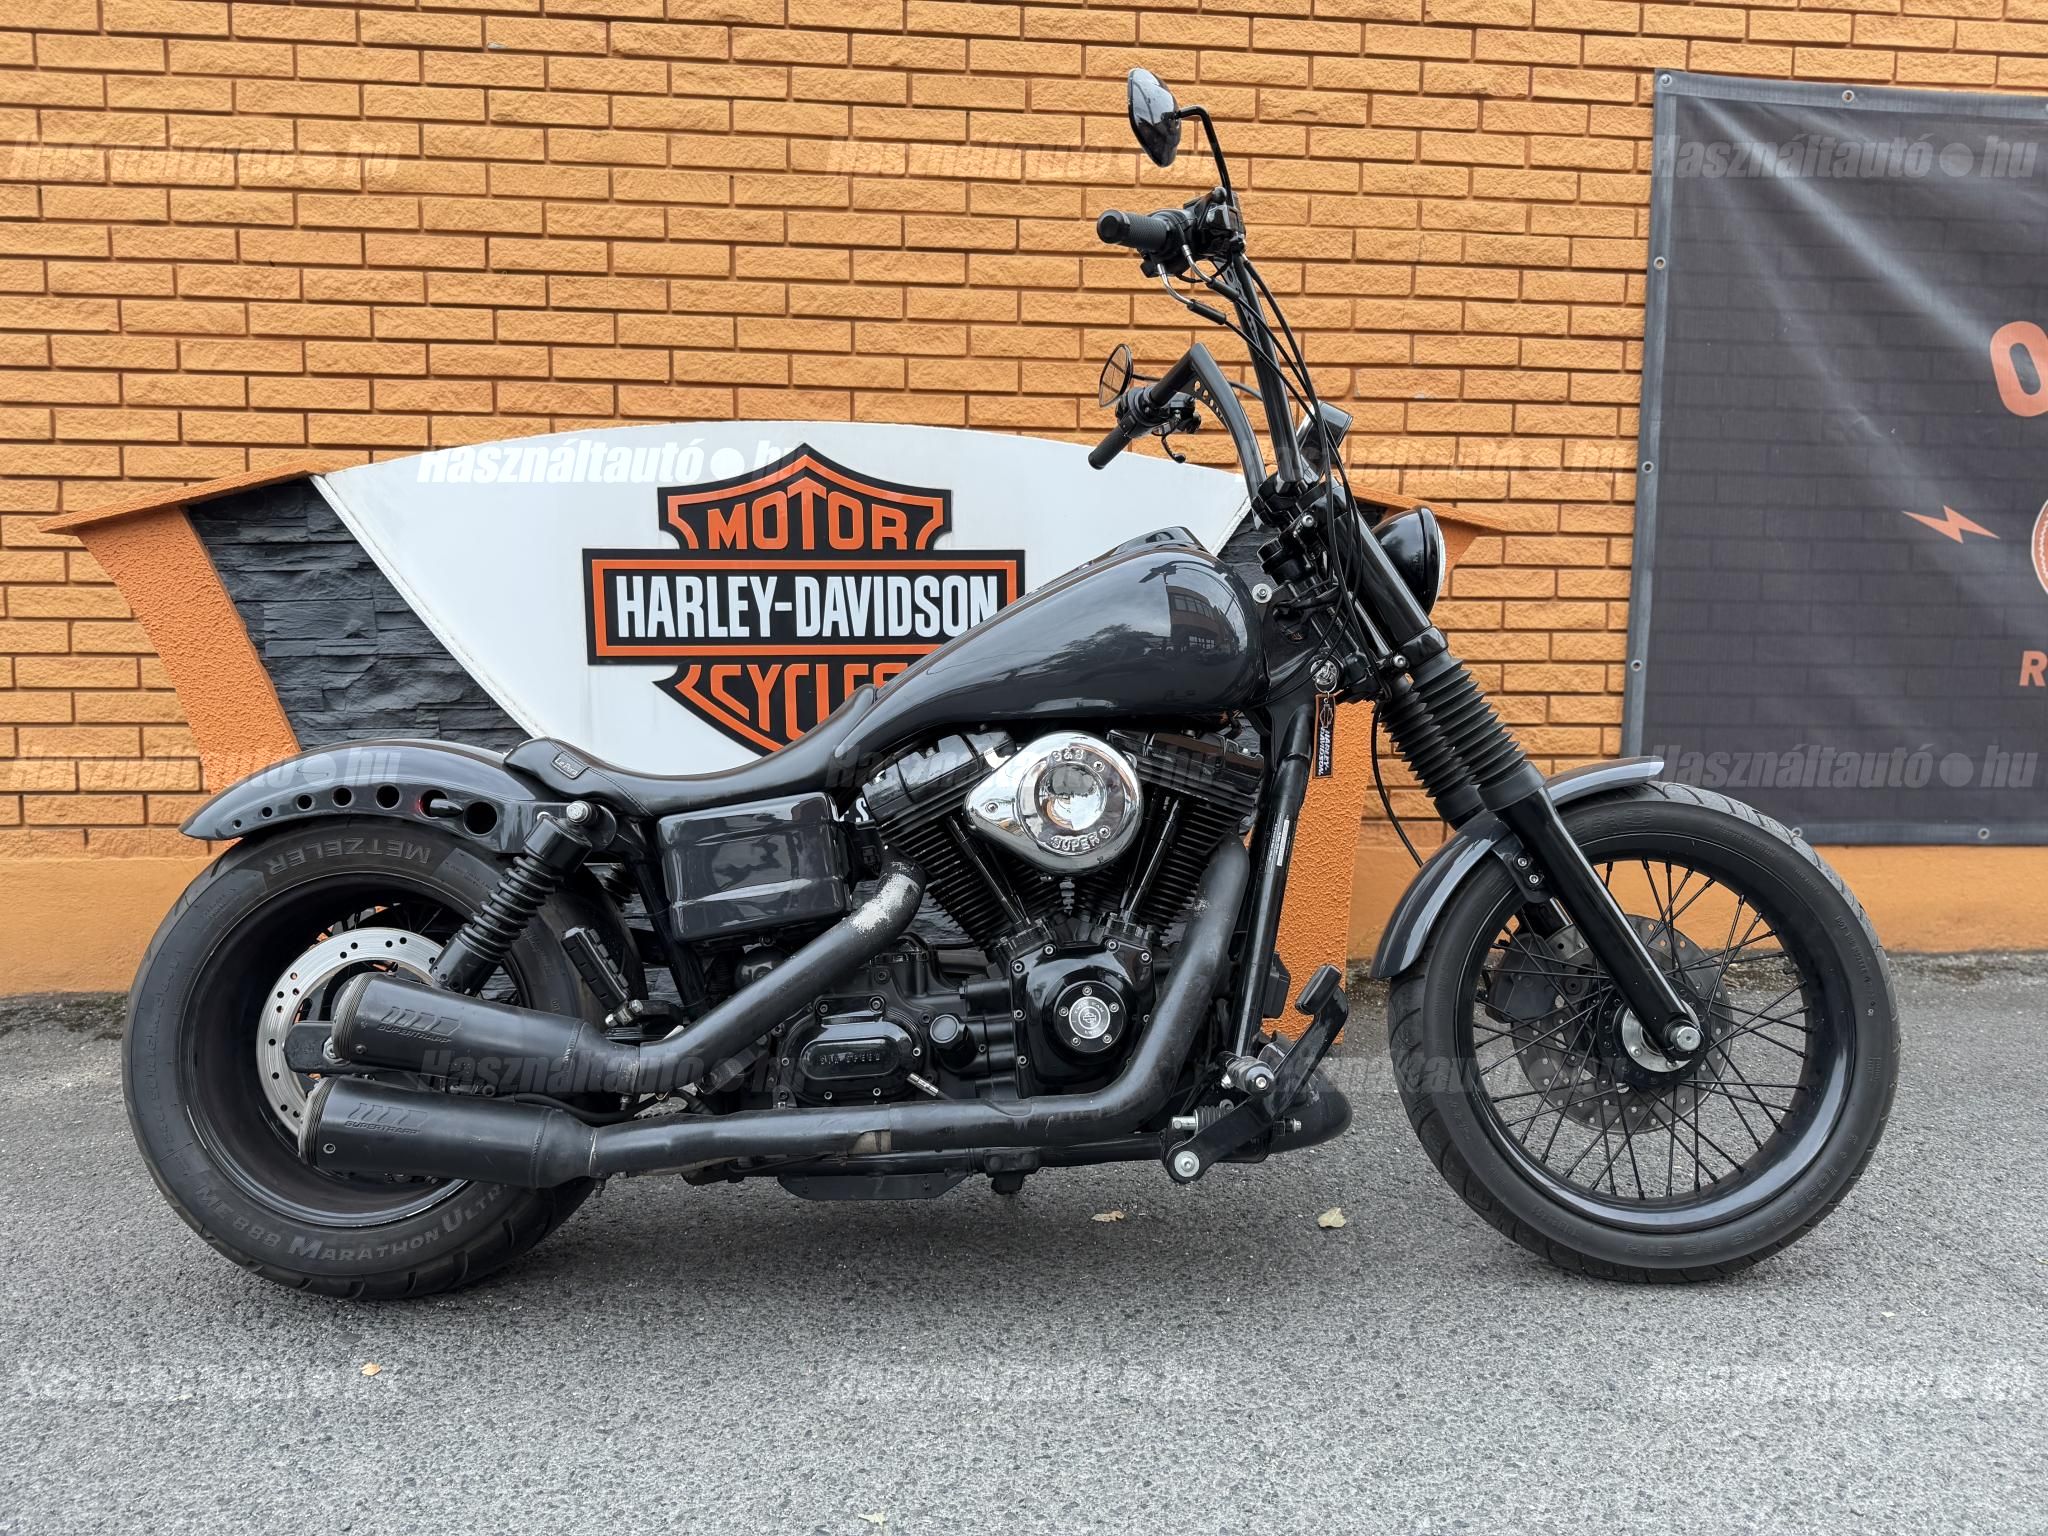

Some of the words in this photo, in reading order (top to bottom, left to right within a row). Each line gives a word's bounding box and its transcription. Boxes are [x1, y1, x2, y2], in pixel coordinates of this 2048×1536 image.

[707, 476, 907, 551] MOTOR
[616, 575, 998, 638] HARLEY-DAVIDSON
[265, 837, 431, 875] METZELER
[1050, 832, 1100, 853] SUPER
[231, 1214, 282, 1248] 888
